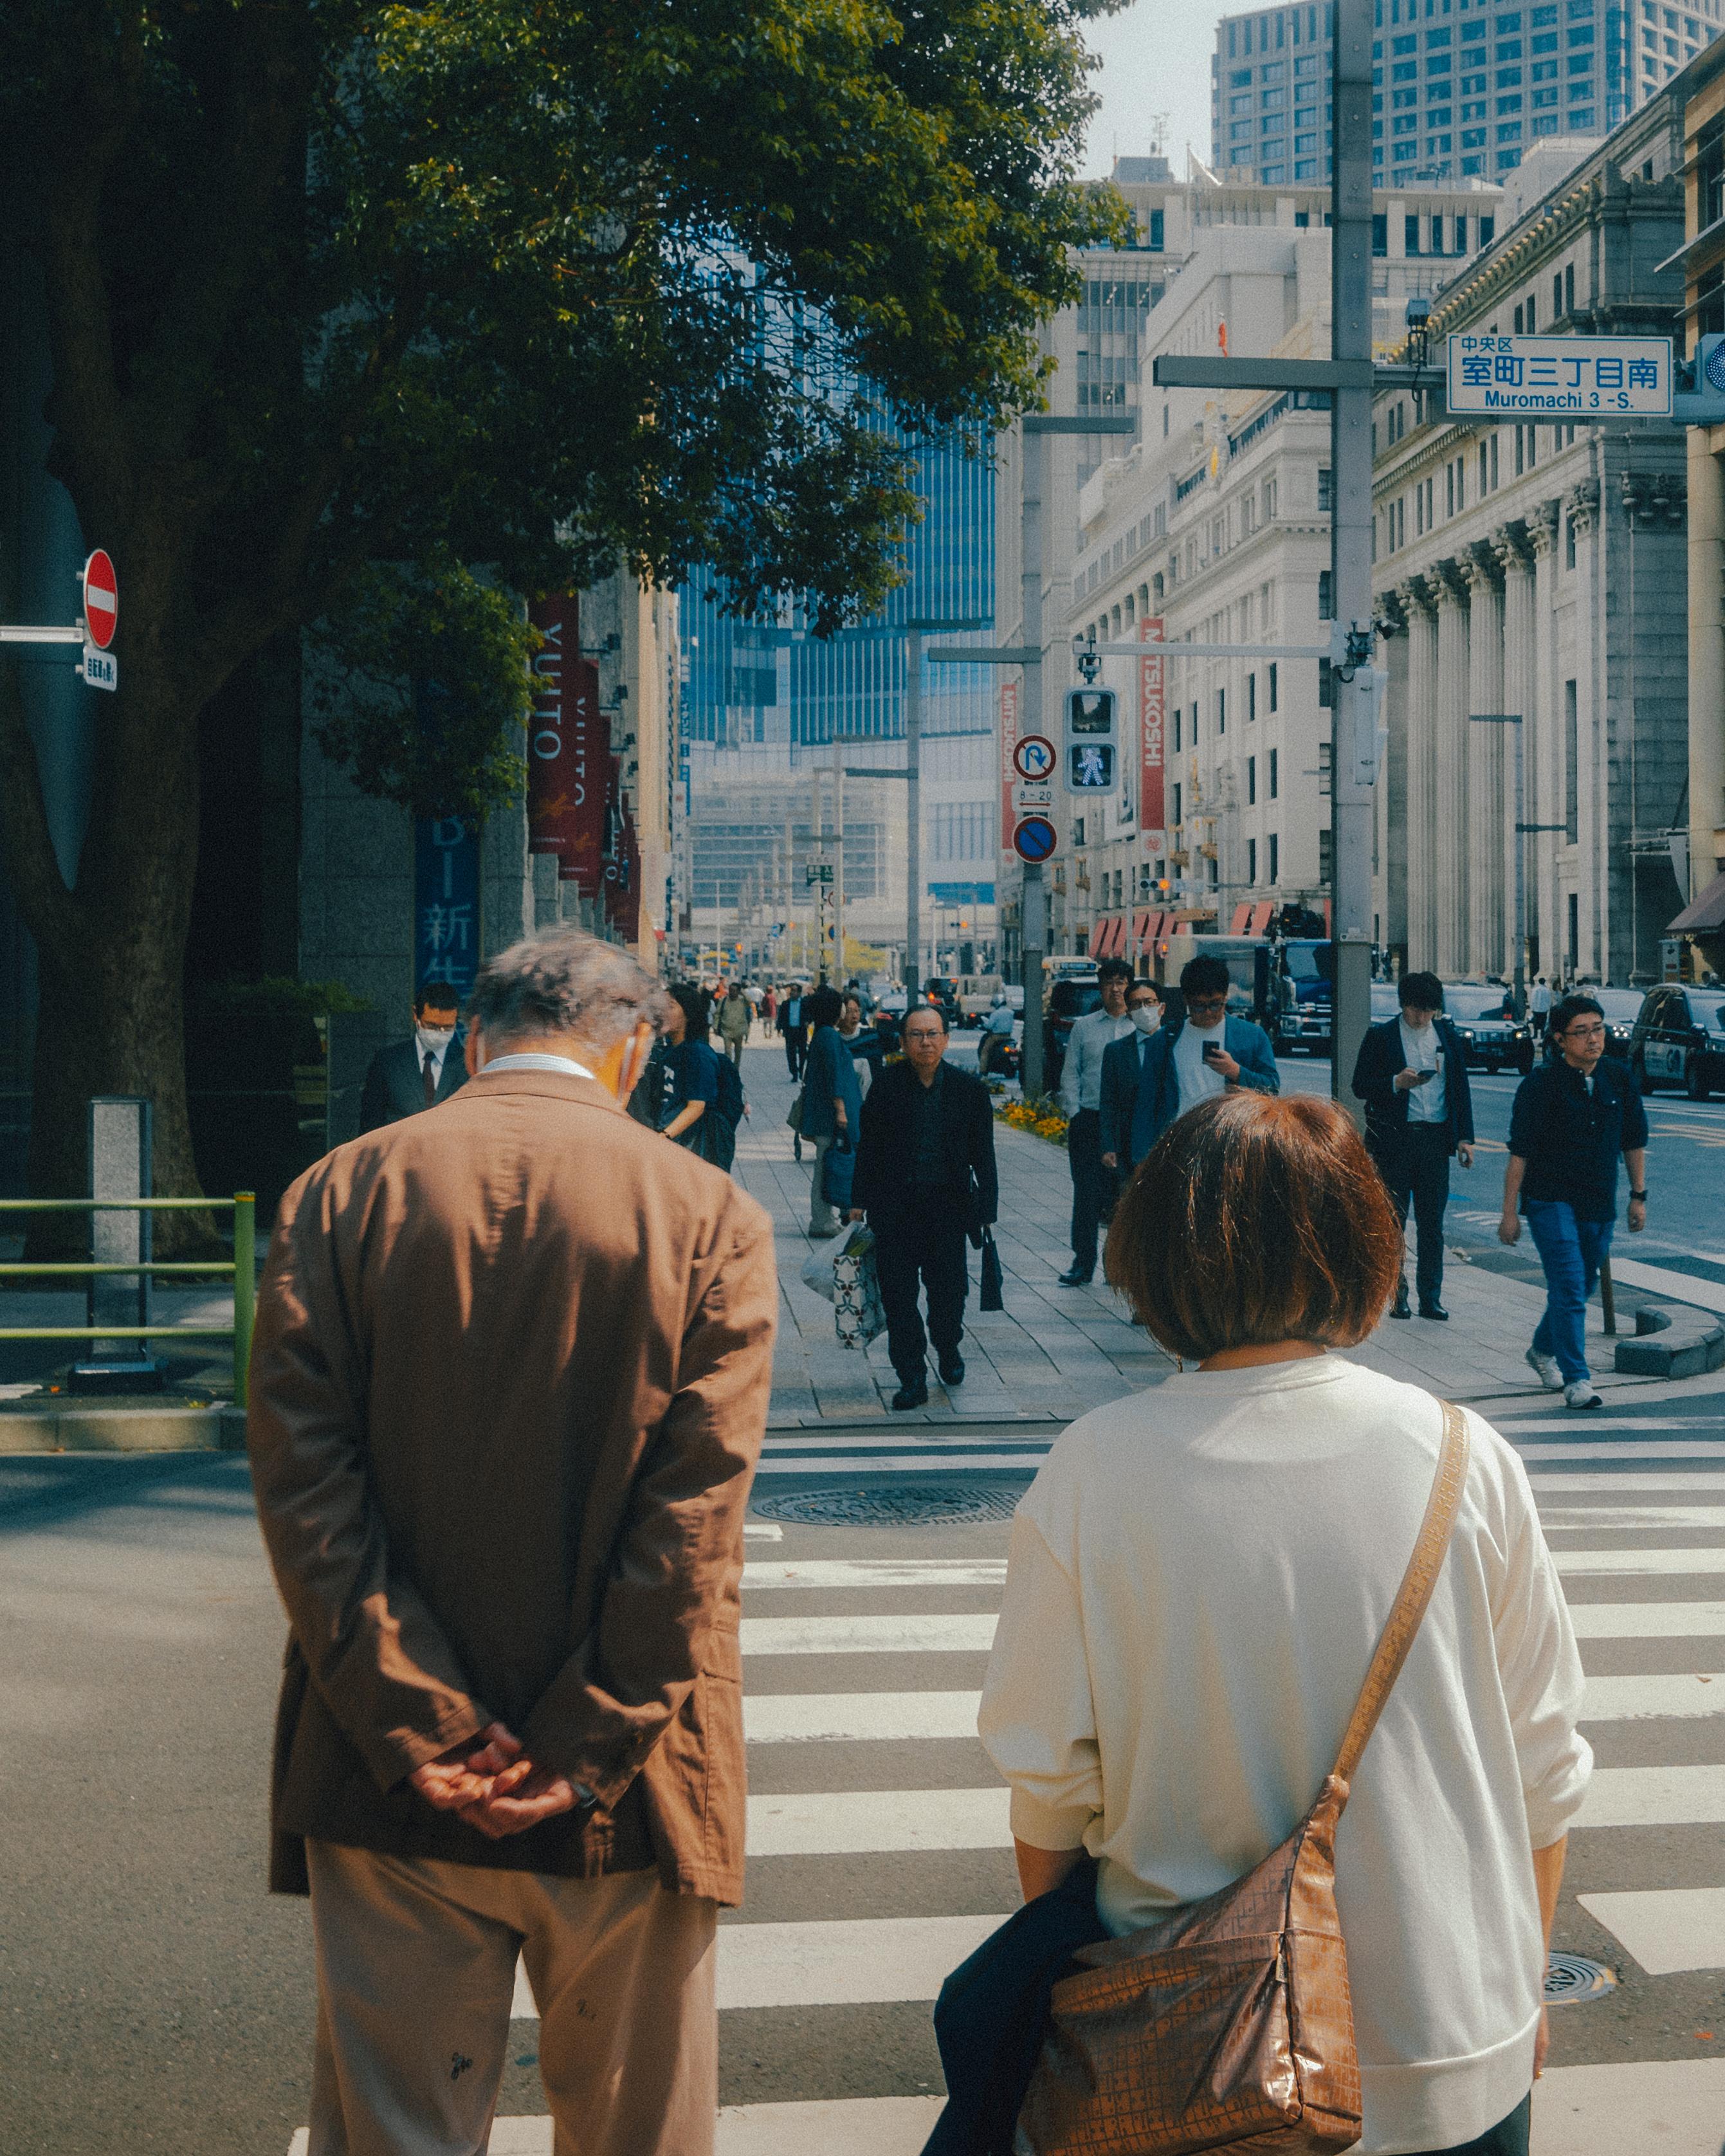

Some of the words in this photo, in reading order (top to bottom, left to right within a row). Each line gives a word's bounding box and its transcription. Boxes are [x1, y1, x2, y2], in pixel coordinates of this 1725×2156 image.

[1461, 336, 1513, 352] 中央区
[1461, 354, 1658, 390] 室町三丁目南
[1485, 390, 1582, 408] Muromachi
[1589, 392, 1600, 408] 3
[534, 622, 563, 760] YUITO
[1145, 628, 1162, 767] MTSUKOSHI
